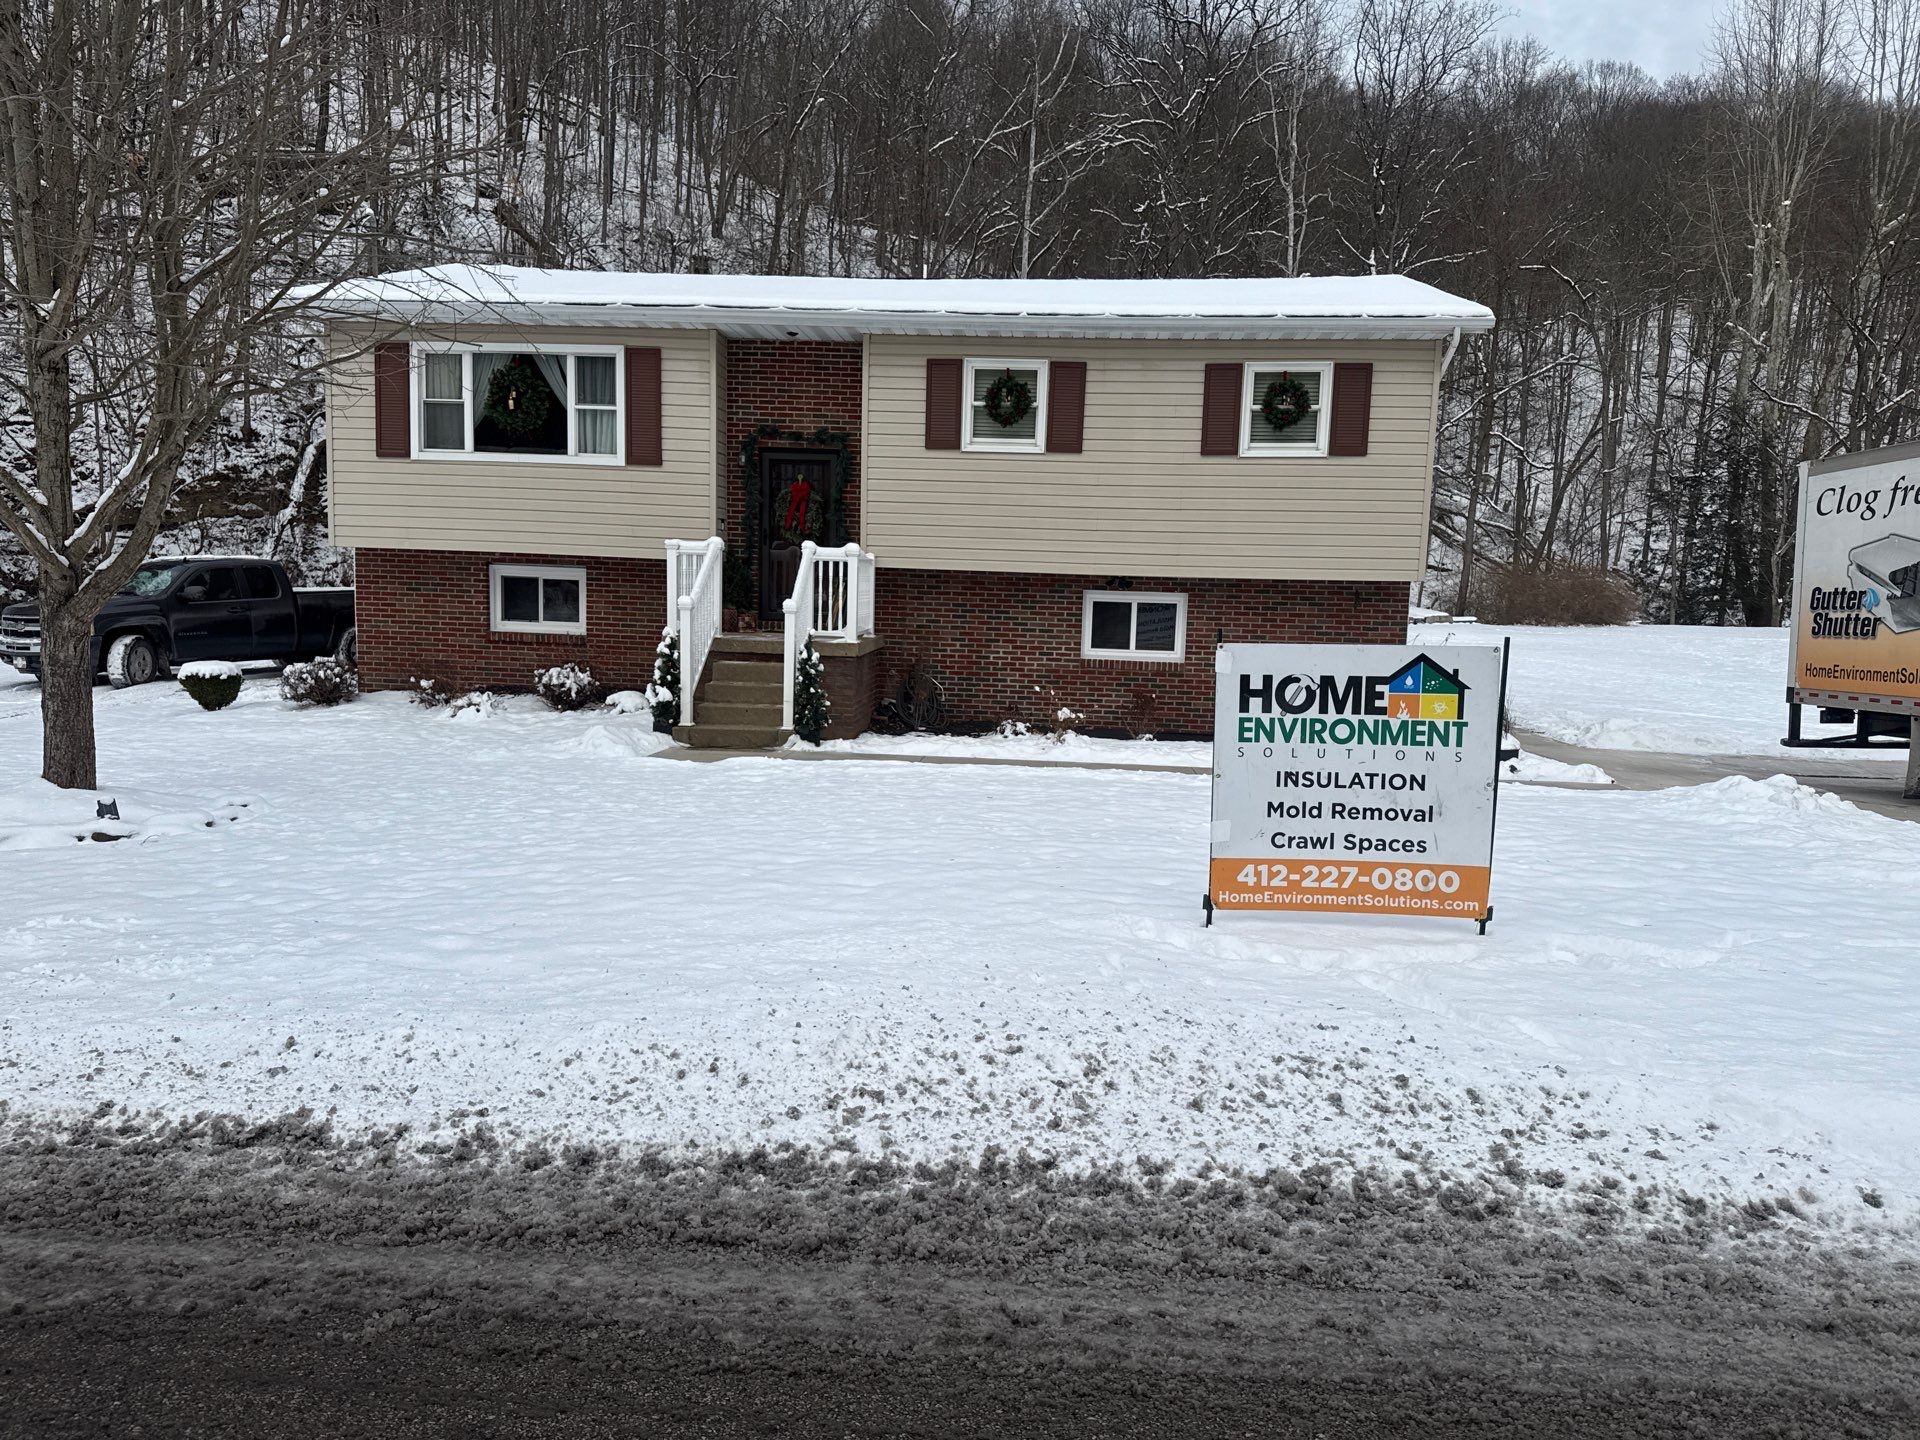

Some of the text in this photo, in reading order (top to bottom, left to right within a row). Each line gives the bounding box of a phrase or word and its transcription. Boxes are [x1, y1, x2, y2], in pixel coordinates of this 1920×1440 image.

[1816, 485, 1881, 520] Clog
[1810, 586, 1867, 611] Gutter
[1811, 612, 1882, 637] Shutter
[1805, 663, 1920, 684] HomeEnvironmentSol
[1238, 673, 1389, 717] HOME
[1237, 717, 1468, 747] ENVIRONMENT
[1237, 747, 1463, 762] SOLUTIONS
[1275, 771, 1426, 791] INSULATION
[1266, 801, 1433, 822] Mold Removal
[1270, 832, 1427, 854] Crawl Spaces
[1237, 864, 1460, 893] 412-227-0800
[1218, 891, 1479, 912] HomeEnvironmentSolutions.com
